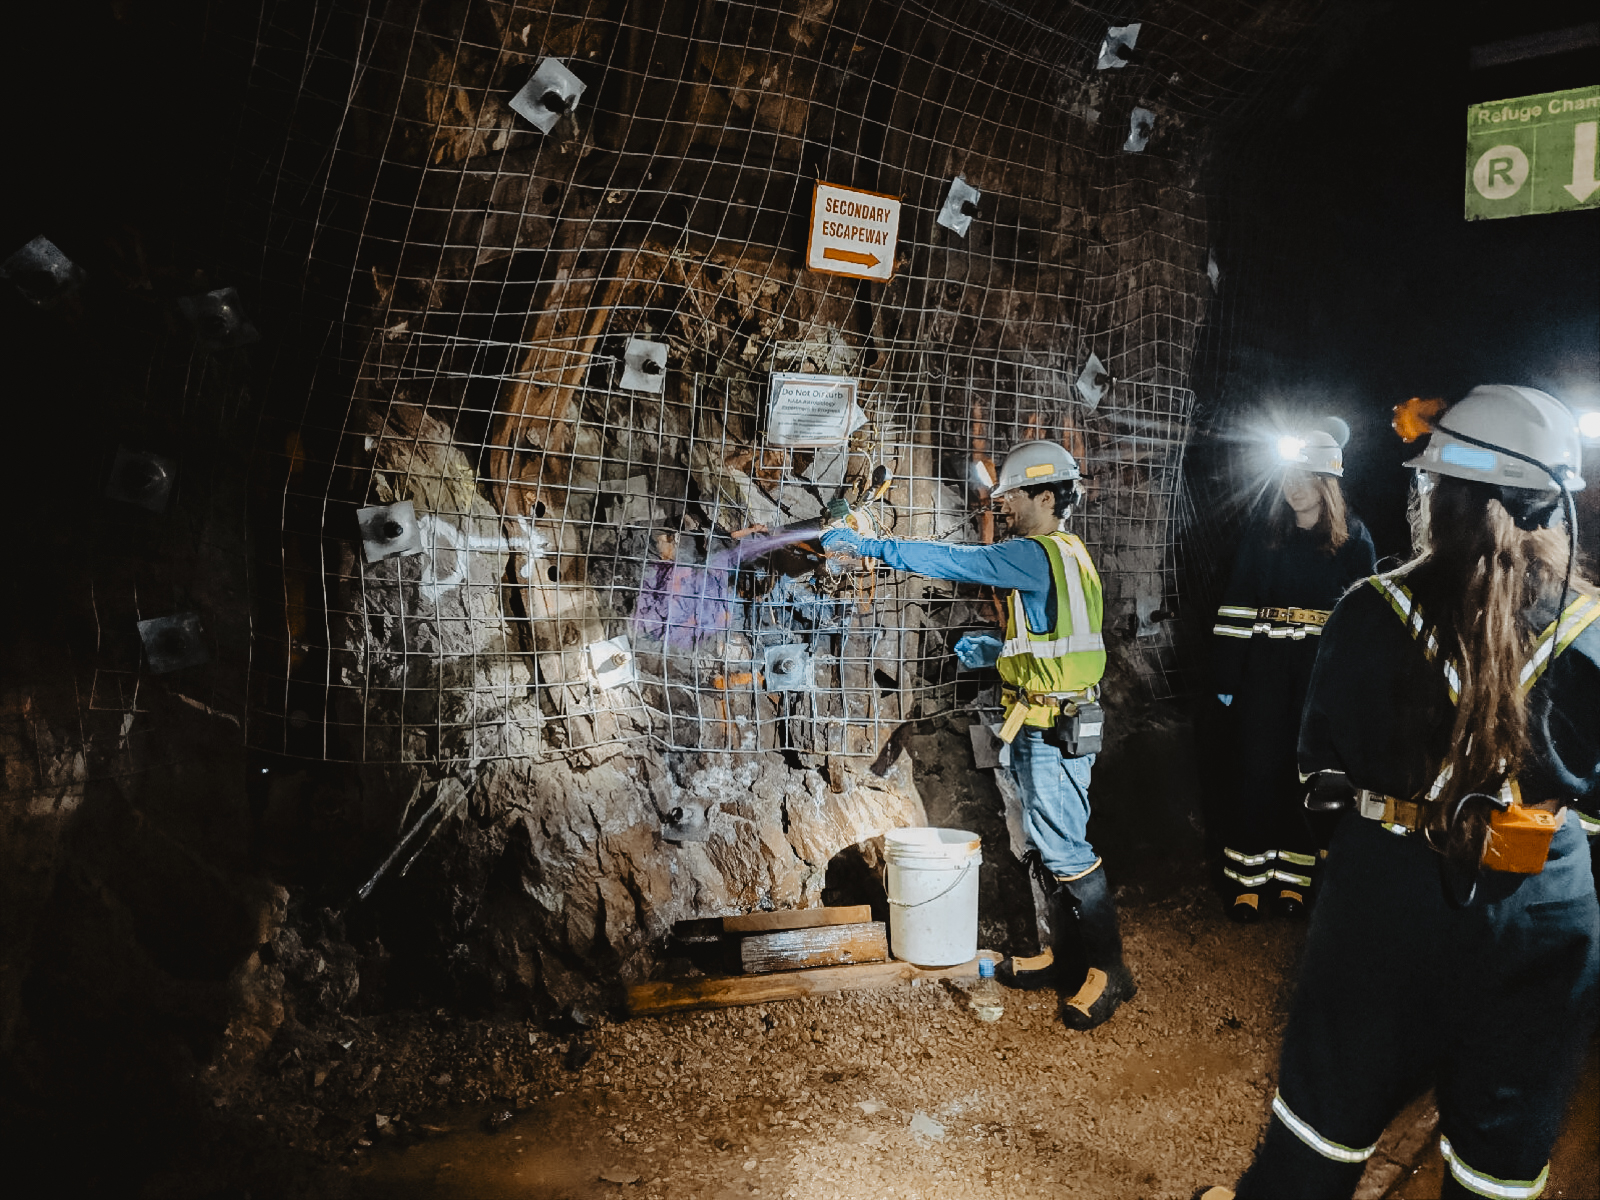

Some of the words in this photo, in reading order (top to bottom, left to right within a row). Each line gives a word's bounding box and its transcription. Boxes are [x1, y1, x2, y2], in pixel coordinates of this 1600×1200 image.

[1478, 105, 1542, 125] Refuge
[1487, 156, 1515, 188] R
[825, 197, 891, 223] SECONDARY
[822, 220, 889, 246] ESCAPEWAY
[782, 388, 794, 396] Do
[796, 389, 811, 397] Not
